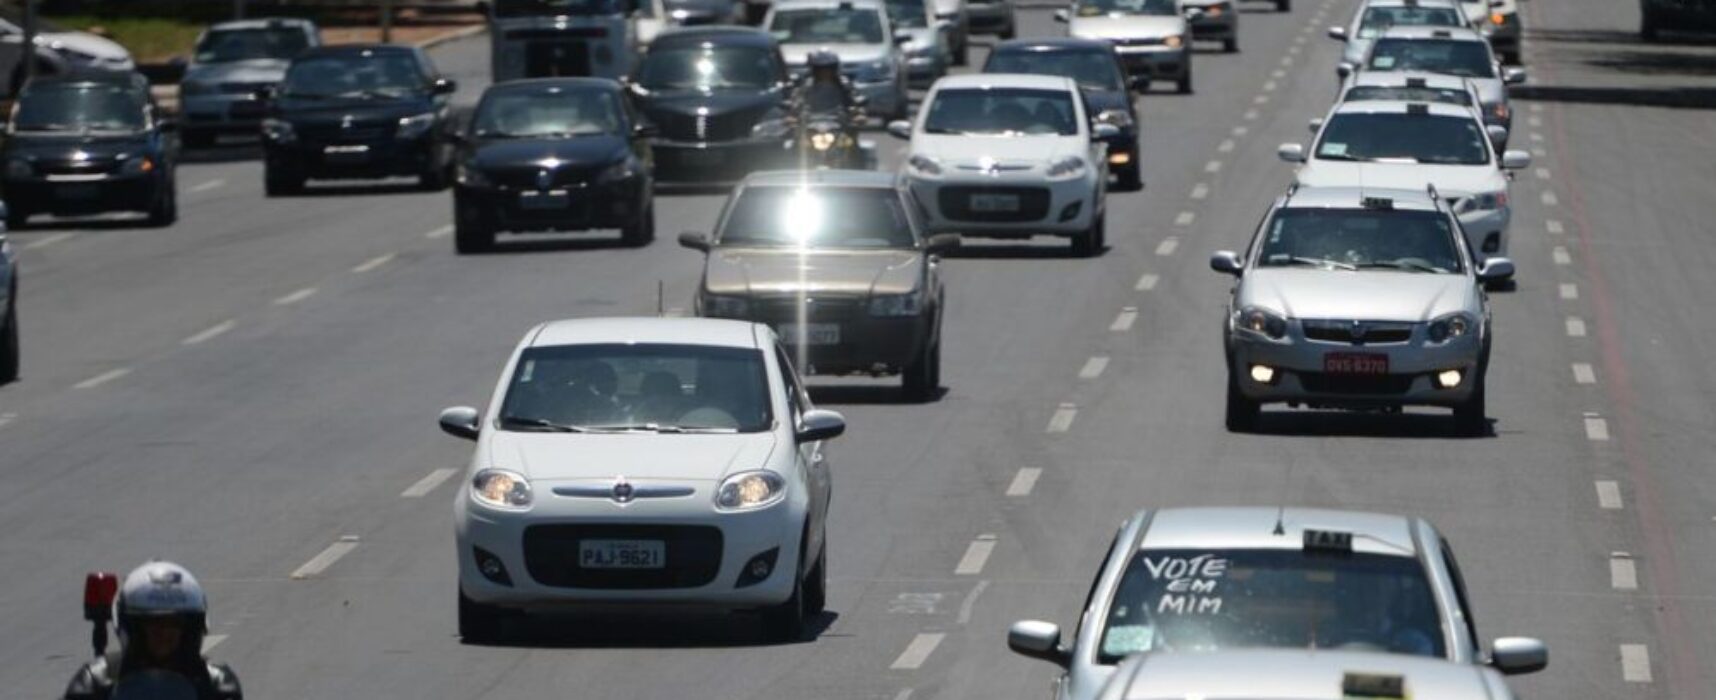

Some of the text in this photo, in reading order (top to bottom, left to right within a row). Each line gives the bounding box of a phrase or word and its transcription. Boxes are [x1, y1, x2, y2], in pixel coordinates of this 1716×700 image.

[1143, 553, 1228, 579] VOTE
[1166, 578, 1217, 593] EM
[1157, 593, 1222, 615] MIM
